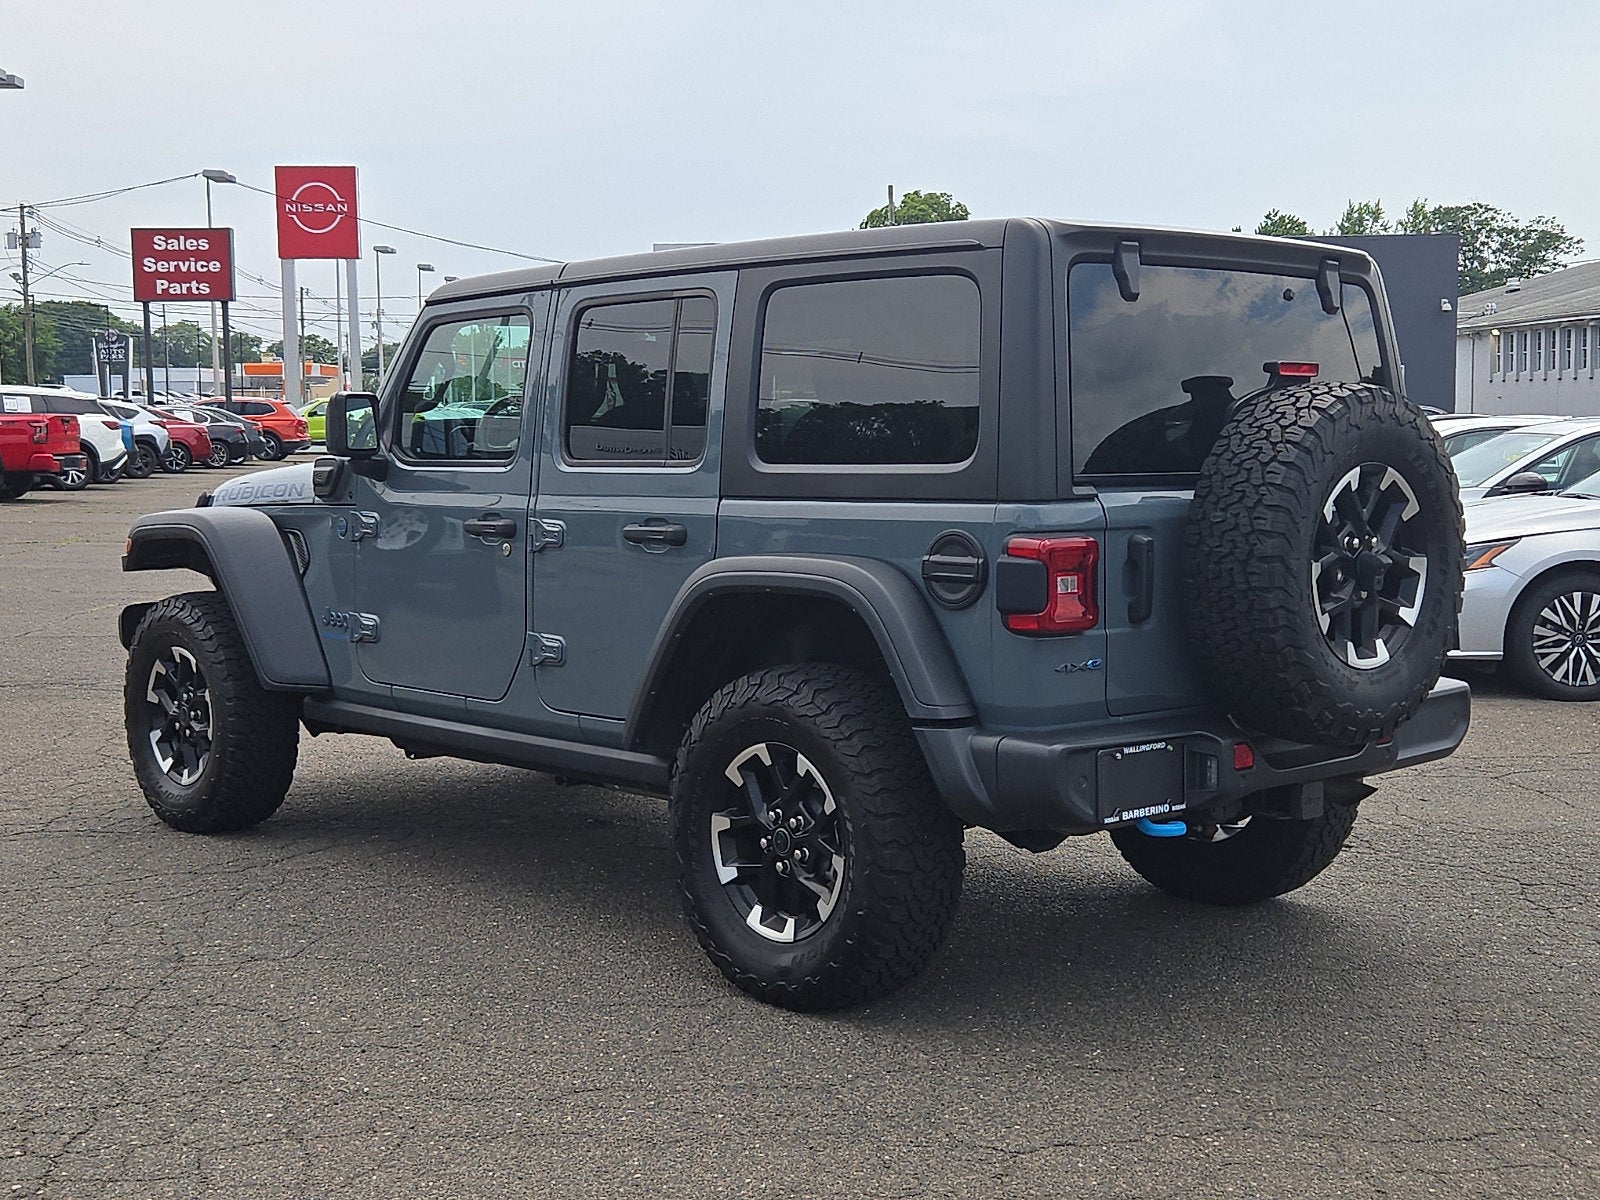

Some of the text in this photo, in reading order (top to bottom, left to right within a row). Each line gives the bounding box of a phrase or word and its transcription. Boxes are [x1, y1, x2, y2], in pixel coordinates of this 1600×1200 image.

[285, 203, 348, 213] NISSAN
[153, 235, 210, 251] Sales
[143, 258, 221, 273] Service
[156, 280, 210, 295] Parts
[215, 482, 306, 502] RUBICON
[321, 605, 350, 632] Jeep
[1123, 741, 1166, 755] WALLINGFORD
[1122, 803, 1170, 821] BARBERINO
